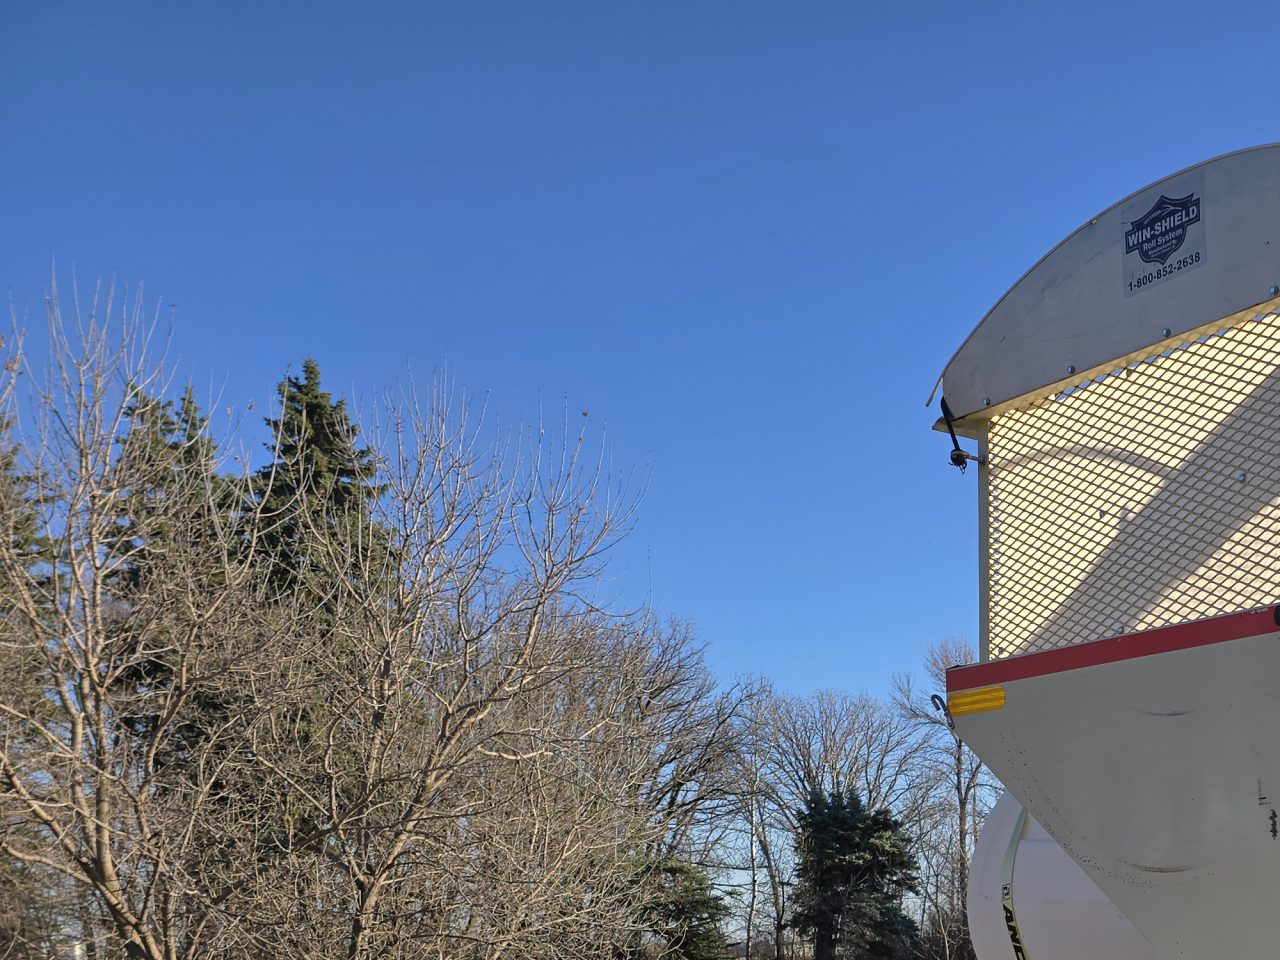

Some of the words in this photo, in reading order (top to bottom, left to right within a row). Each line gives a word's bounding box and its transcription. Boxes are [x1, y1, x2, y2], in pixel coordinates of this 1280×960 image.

[1128, 205, 1198, 247] WIN-SHIELD
[1143, 239, 1157, 252] Roll
[1157, 229, 1183, 245] System
[1128, 252, 1201, 291] 1-800-852-2638
